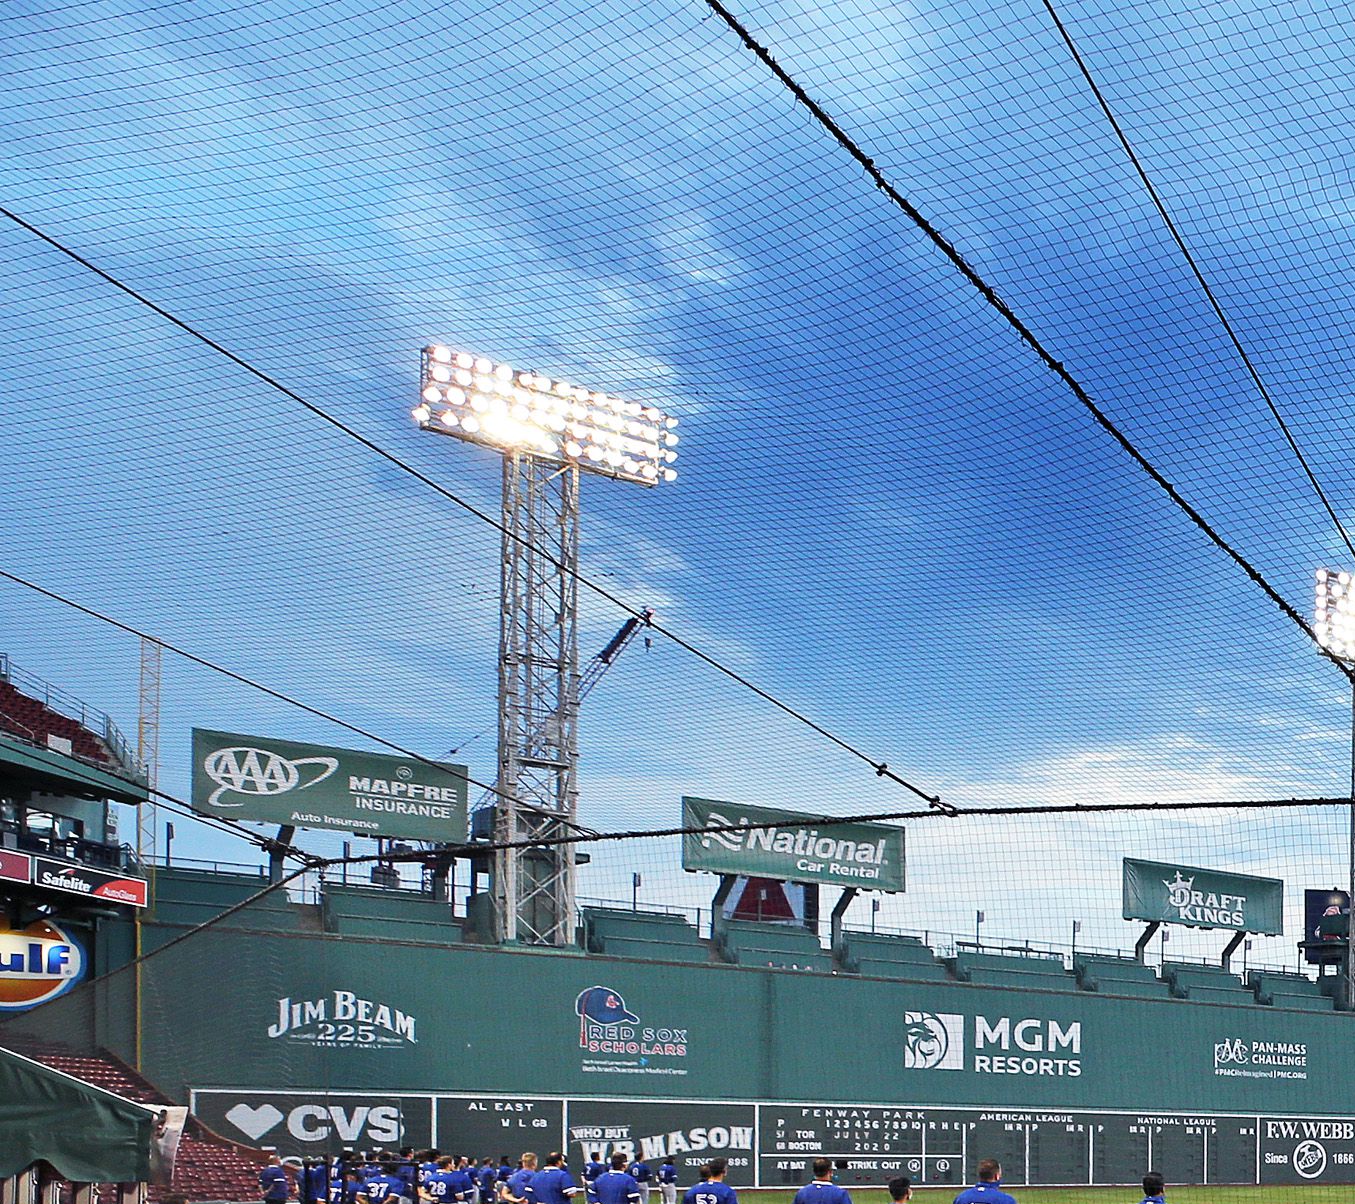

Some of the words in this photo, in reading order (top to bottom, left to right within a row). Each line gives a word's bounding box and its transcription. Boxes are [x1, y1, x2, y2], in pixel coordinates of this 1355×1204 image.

[212, 749, 296, 795] AAA
[349, 775, 457, 802] MAPFRE
[355, 796, 453, 819] INSURANCE
[290, 811, 321, 824] Auto
[323, 814, 380, 830] Insurance
[746, 822, 889, 865] National
[796, 859, 824, 873] Car
[829, 863, 880, 879] Rental
[41, 871, 92, 893] Safelite
[1168, 887, 1247, 912] DRAFT
[1179, 907, 1245, 927] KINGS
[0, 943, 70, 975] ulf
[267, 997, 327, 1038] JIM
[333, 990, 418, 1044] BEAM
[317, 1023, 376, 1042] 225
[588, 1025, 635, 1041] RED
[642, 1027, 688, 1043] SOX
[975, 1015, 1081, 1054] MGM
[588, 1040, 687, 1056] SCHOLARS
[1252, 1041, 1307, 1055] PAN-MASS
[975, 1055, 1082, 1077] RESORTS
[1251, 1054, 1307, 1067] CHALLENGE
[468, 1102, 487, 1112] AL
[495, 1102, 534, 1112] EAST
[801, 1108, 871, 1119] FENWAY
[883, 1110, 926, 1120] PARK
[286, 1104, 403, 1142] CVS
[518, 1118, 526, 1128] L
[777, 1118, 785, 1127] P
[979, 1112, 1032, 1122] AMERICAN
[1036, 1114, 1073, 1123] LEAGUE
[1137, 1117, 1180, 1125] NATIONAL
[1183, 1118, 1217, 1126] LEAGUE
[571, 1128, 603, 1139] WHO
[605, 1127, 629, 1138] BUT
[796, 1130, 815, 1139] TOR
[1266, 1121, 1300, 1139] F.W.
[1301, 1122, 1355, 1139] WEBB
[640, 1126, 753, 1161] MASON
[847, 1160, 878, 1170] STRIKE
[882, 1160, 901, 1169] OUT
[1264, 1153, 1288, 1164] Since
[1332, 1154, 1355, 1164] 1866
[367, 1182, 389, 1198] 37
[428, 1181, 446, 1196] 28
